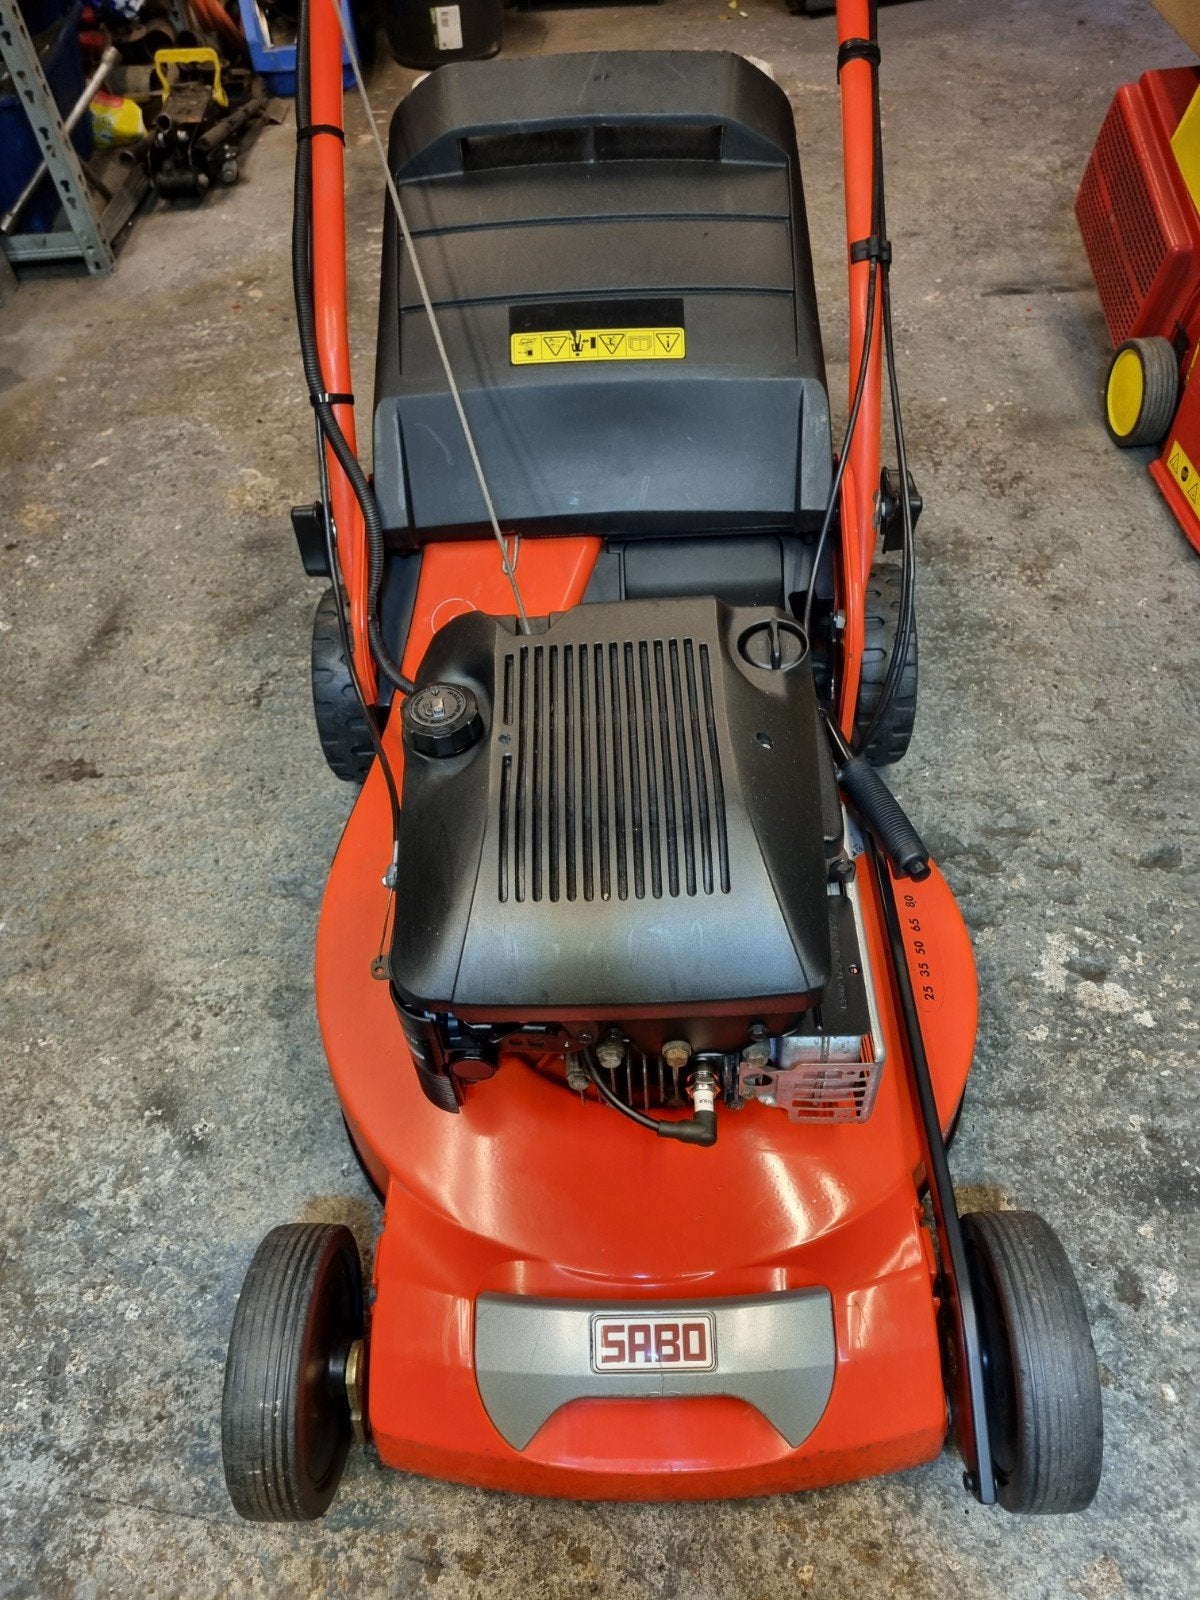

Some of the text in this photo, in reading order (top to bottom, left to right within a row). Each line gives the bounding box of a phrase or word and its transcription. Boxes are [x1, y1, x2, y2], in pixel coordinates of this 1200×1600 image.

[904, 895, 935, 1000] 25 35 50 65 80
[602, 1323, 706, 1363] SABO
